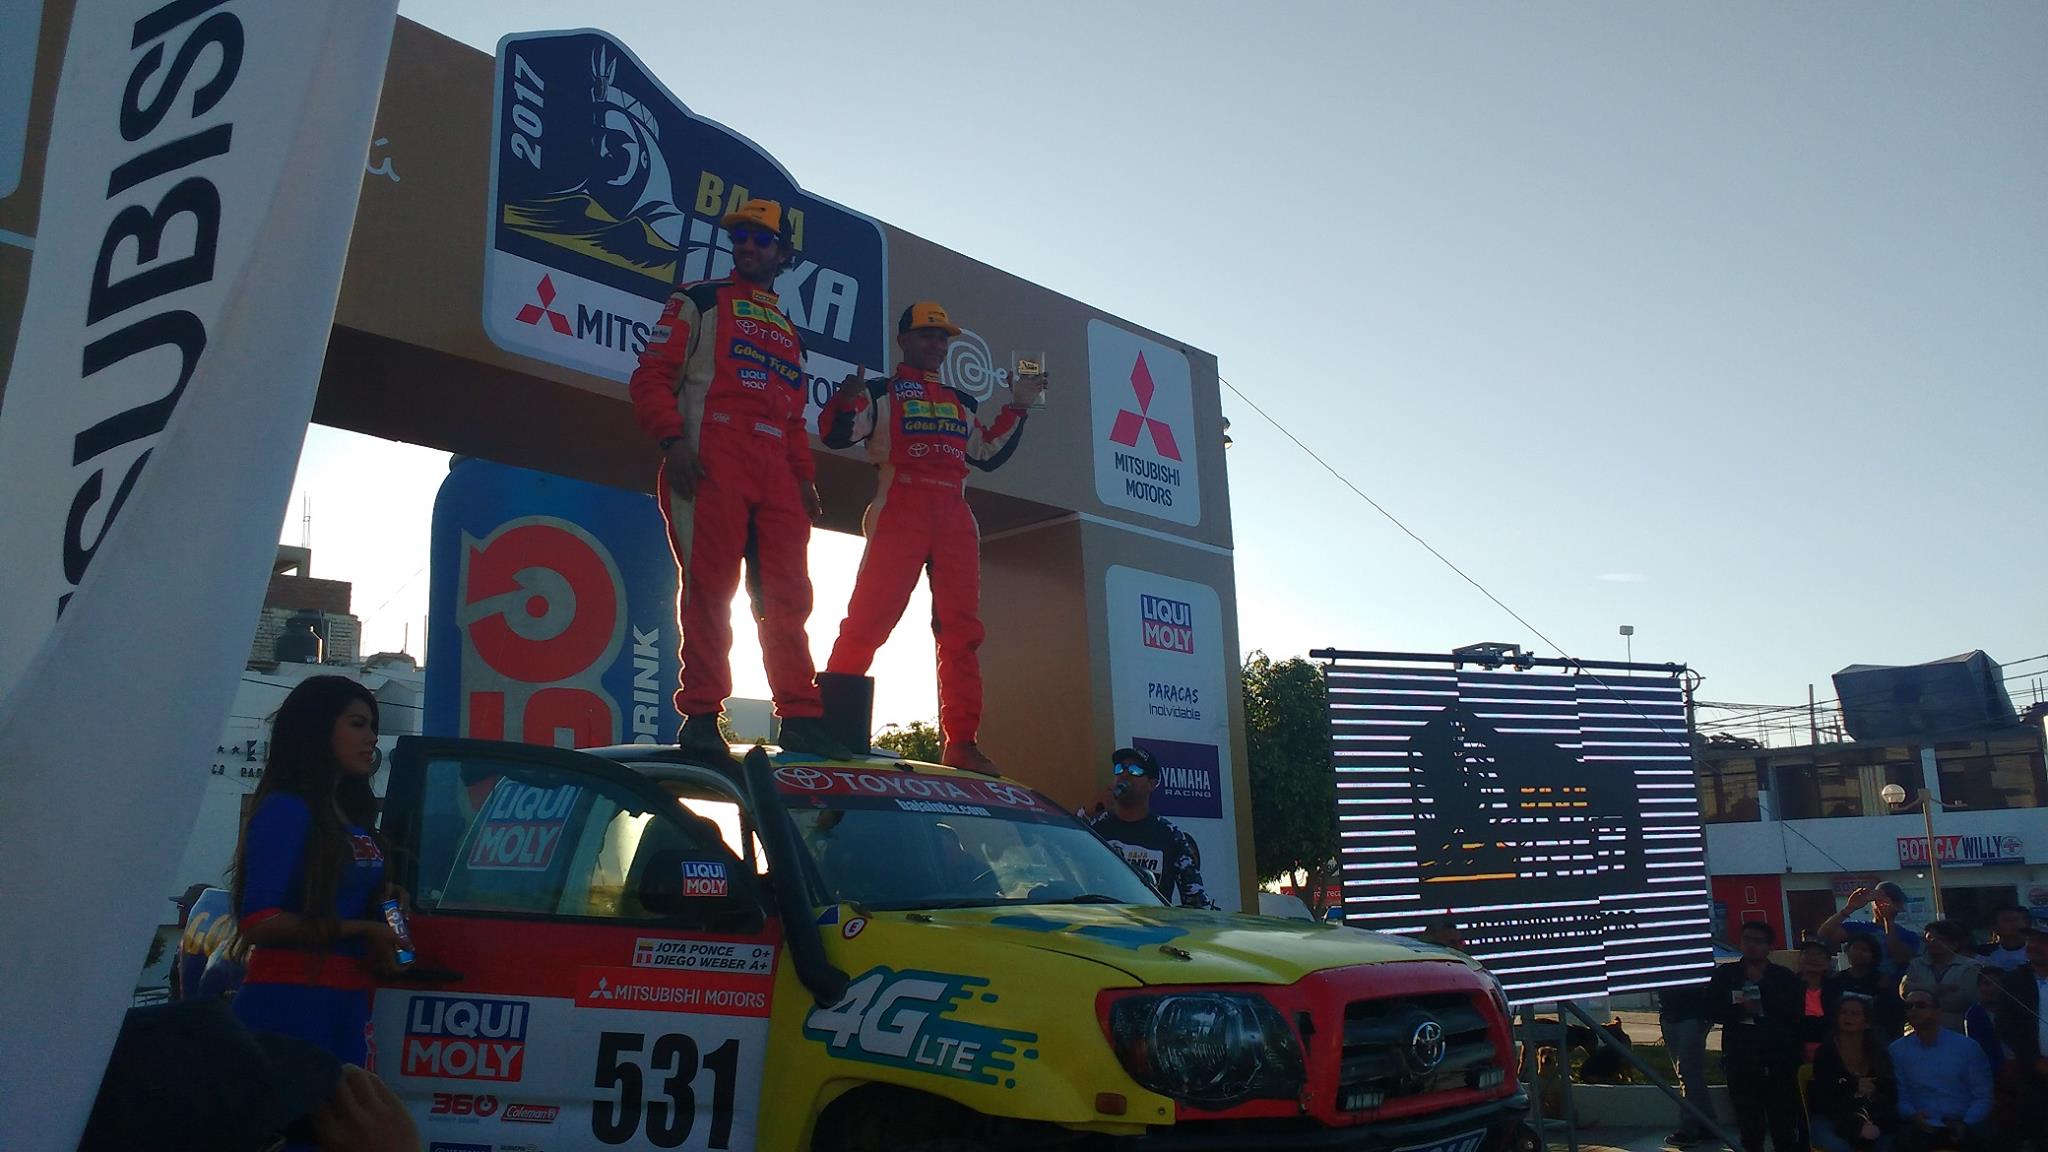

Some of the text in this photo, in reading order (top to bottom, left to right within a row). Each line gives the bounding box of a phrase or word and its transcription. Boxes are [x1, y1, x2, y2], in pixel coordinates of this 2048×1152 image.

[510, 53, 545, 170] 2017
[694, 170, 806, 252] BAA
[740, 369, 768, 381] LIQUI
[742, 380, 768, 390] MOLY
[1114, 451, 1180, 487] MITSUBISHI
[1126, 478, 1173, 507] MOTORS
[1143, 596, 1190, 626] LIQUI
[1144, 622, 1192, 651] MOLY
[633, 624, 660, 745] RINK
[1148, 682, 1199, 704] PARACAS
[1149, 703, 1201, 720] Inolvidable
[833, 771, 970, 800] TOYOTA
[1160, 766, 1211, 790] YAMAHA
[491, 782, 577, 821] LIQUI
[1164, 789, 1212, 799] RACING
[474, 826, 559, 865] MOLY
[1899, 835, 2002, 861] BOTCA WILLY
[685, 862, 725, 879] LIQUI
[686, 879, 727, 895] MOLY
[655, 941, 687, 954] JOTA
[689, 944, 735, 957] PONCE
[654, 954, 768, 972] DIEGO WEBER A+
[614, 984, 766, 1008] MITSUBISHI MOTORS
[411, 998, 524, 1040] LIQUI
[807, 973, 982, 1072] 4G LTE
[407, 1039, 522, 1078] MOLY
[591, 1031, 741, 1150] 531
[430, 1092, 499, 1118] 360
[506, 1105, 547, 1121] Coleman
